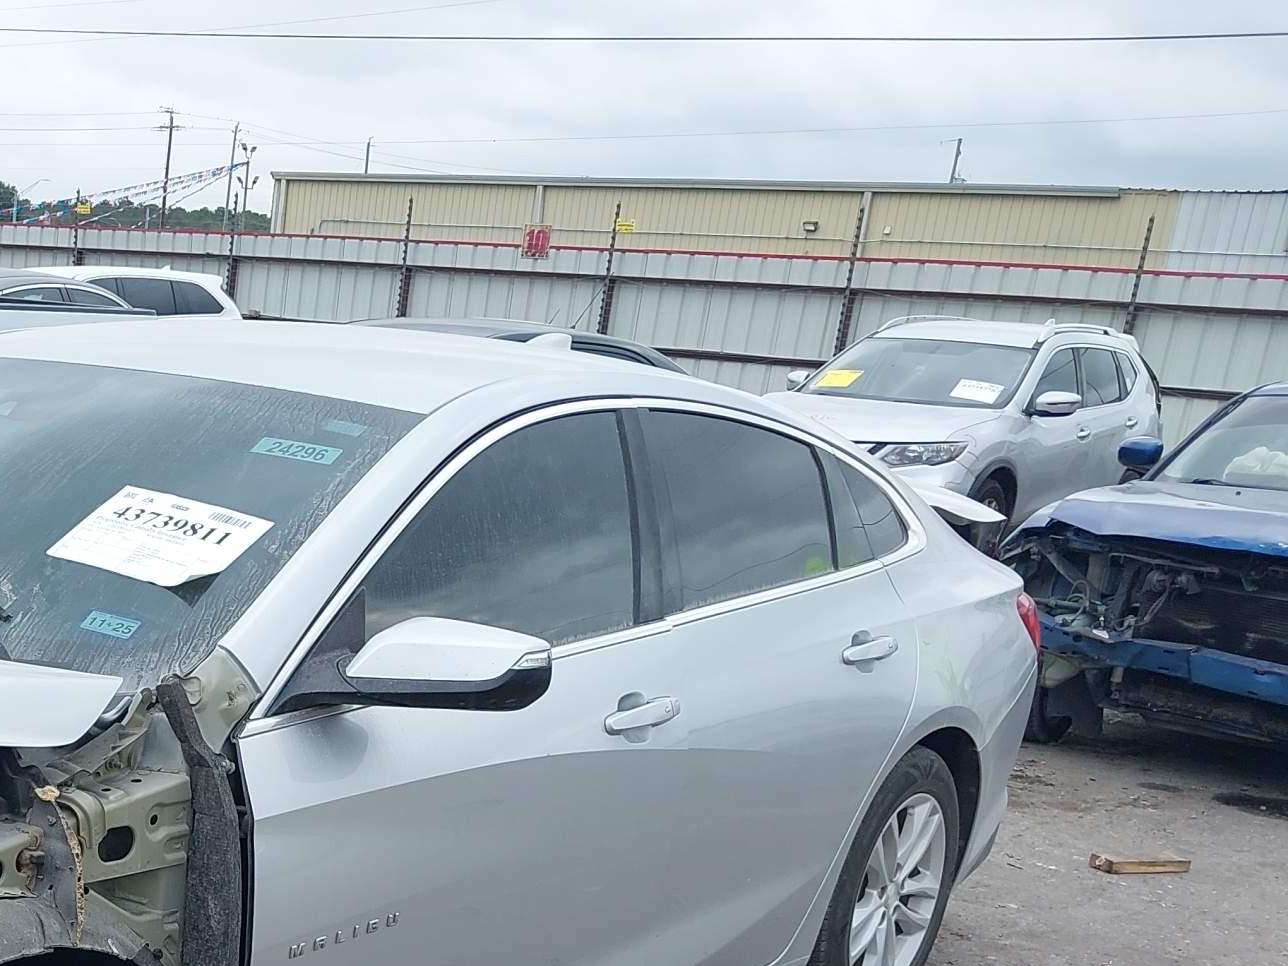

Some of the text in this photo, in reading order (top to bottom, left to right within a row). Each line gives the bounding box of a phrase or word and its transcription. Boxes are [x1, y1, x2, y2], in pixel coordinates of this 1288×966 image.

[264, 441, 329, 461] 24296
[113, 505, 233, 546] 43739811
[288, 911, 400, 960] MALIBU
